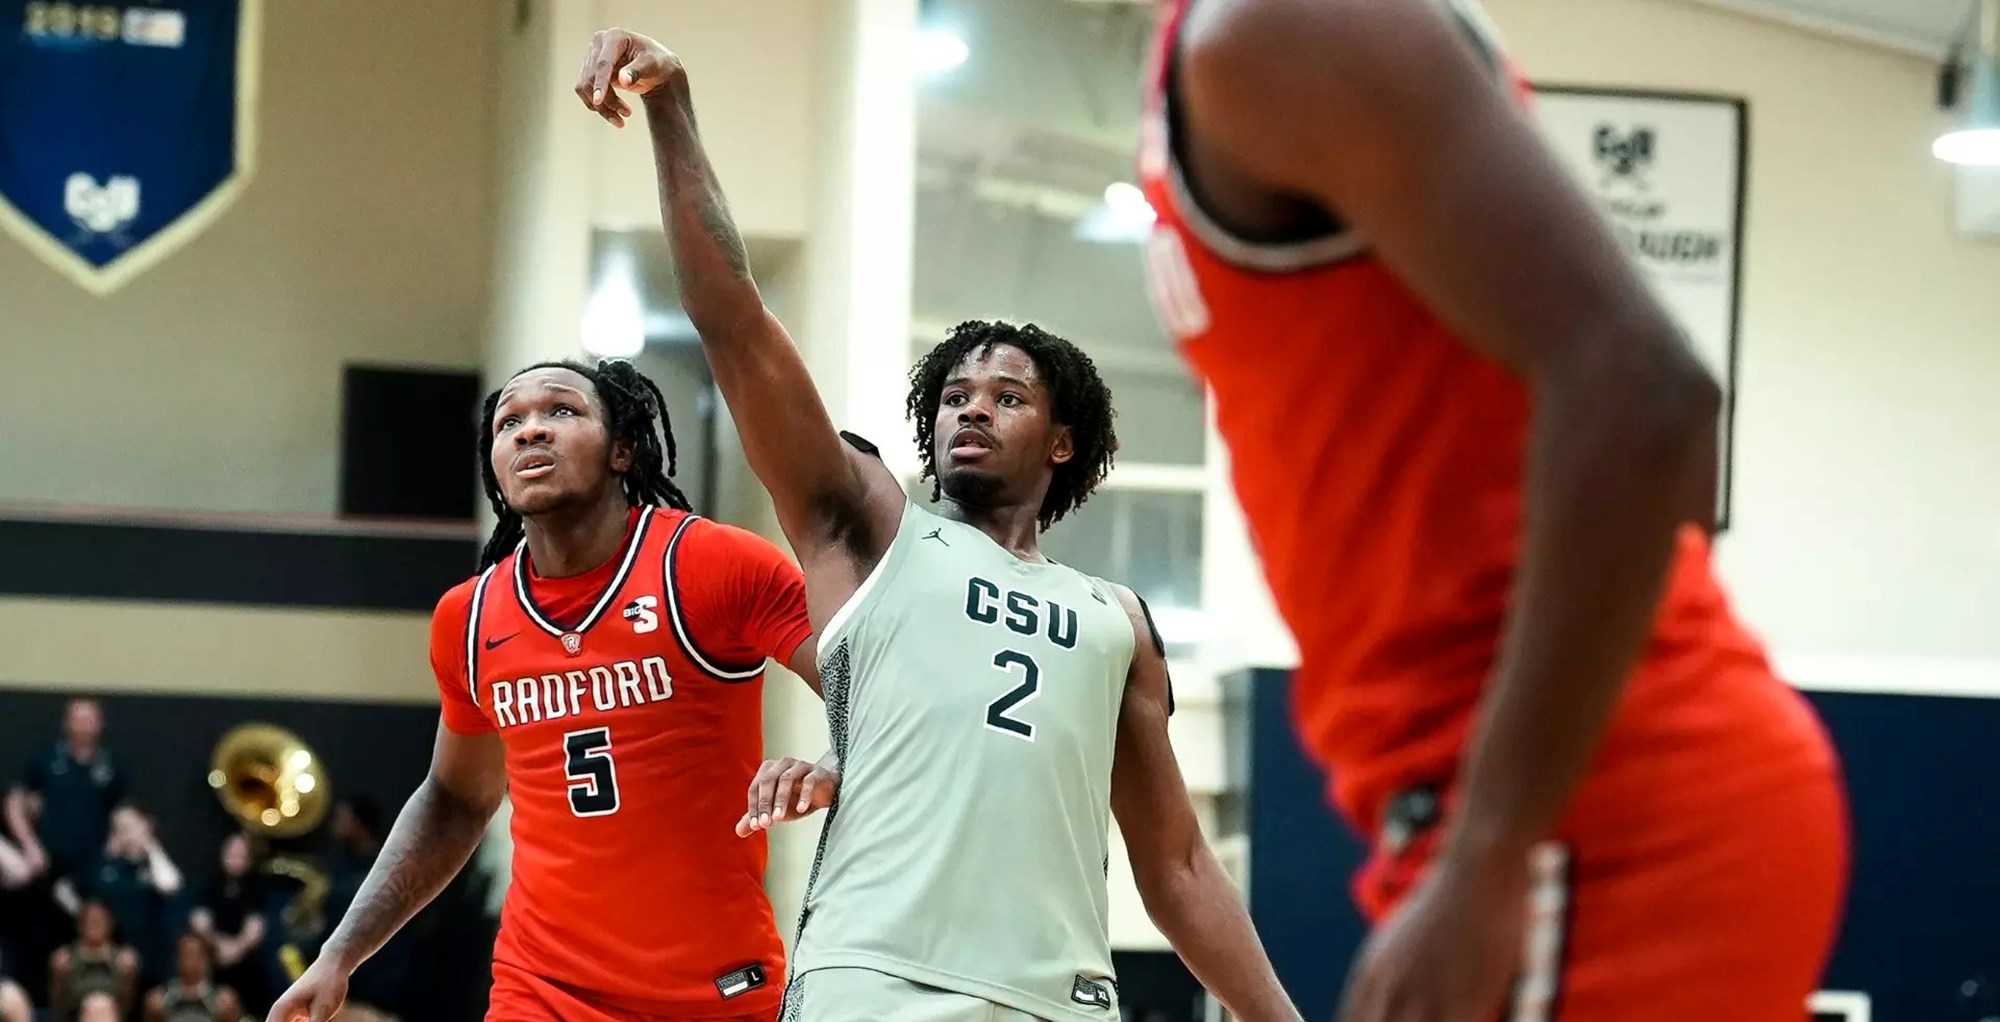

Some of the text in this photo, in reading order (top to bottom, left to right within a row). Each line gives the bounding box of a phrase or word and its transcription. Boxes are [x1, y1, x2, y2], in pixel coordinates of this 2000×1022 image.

[966, 576, 1079, 650] CSU
[491, 656, 674, 728] RADFORD
[984, 649, 1042, 743] 2
[562, 726, 621, 818] 5
[751, 971, 759, 981] L
